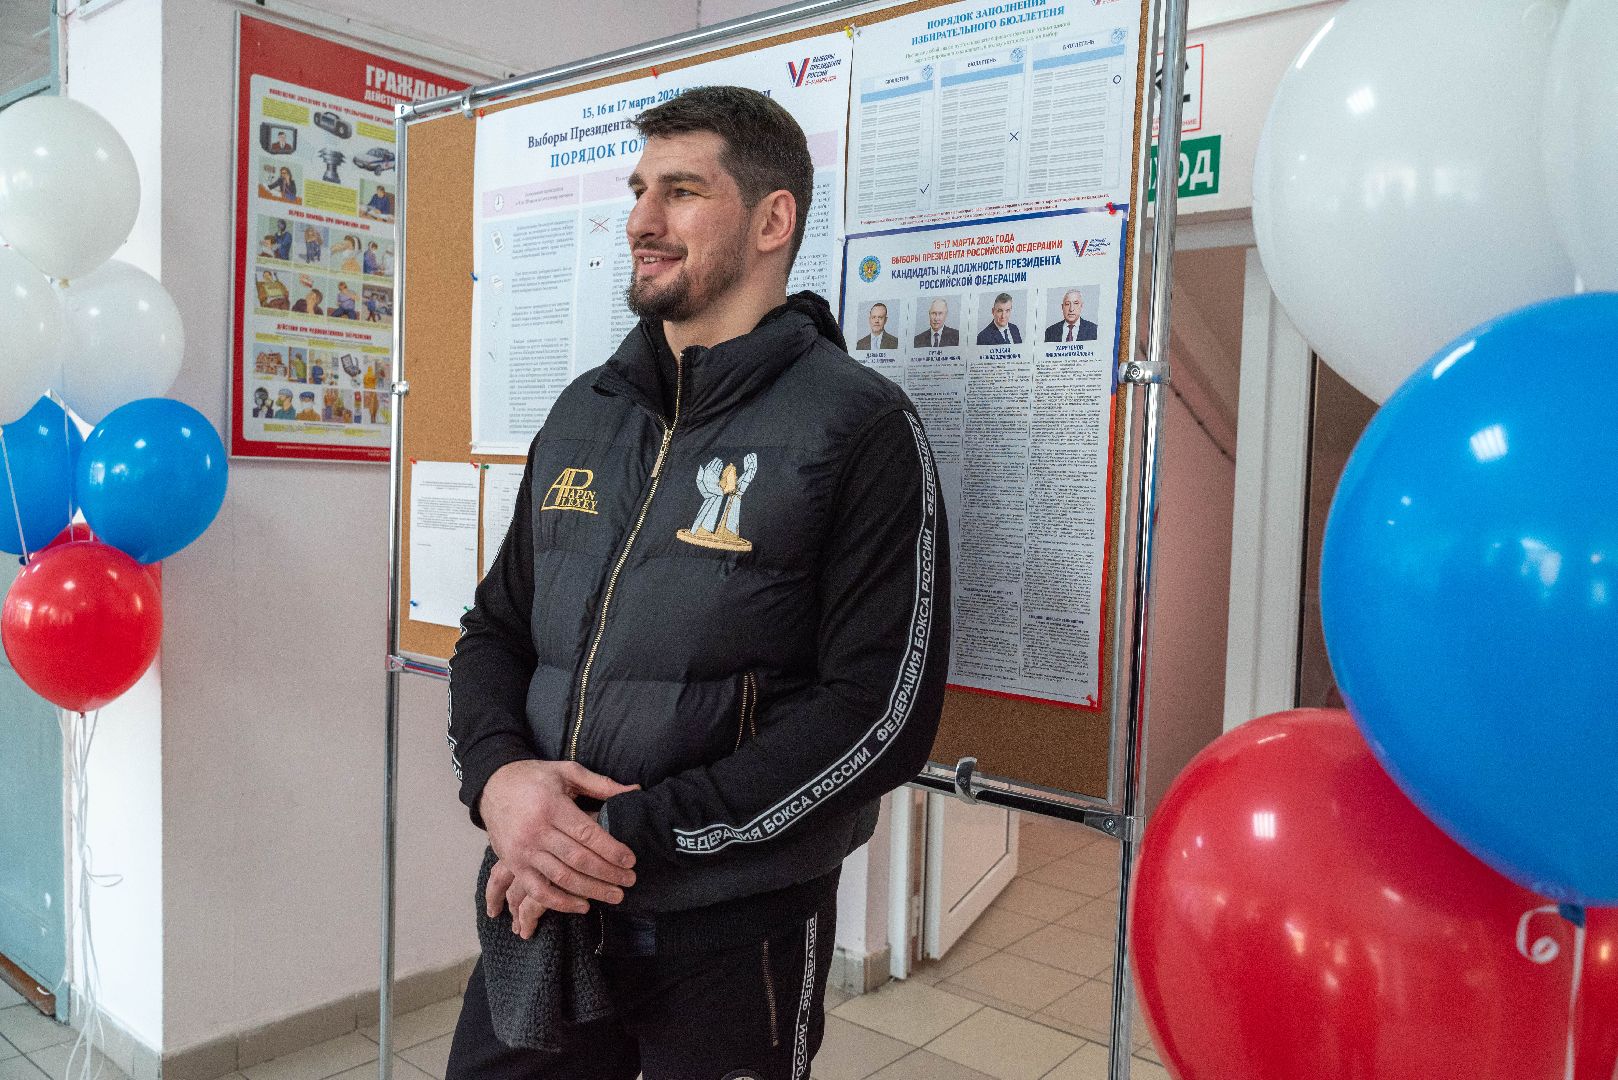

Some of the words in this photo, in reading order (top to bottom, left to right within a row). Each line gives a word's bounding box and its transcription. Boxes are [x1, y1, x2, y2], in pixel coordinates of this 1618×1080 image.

[911, 19, 997, 46] ИЗБИРАТЕЛЬНОГО
[999, 5, 1065, 27] БЮЛЛЕТЕНЯ
[927, 11, 973, 30] ПОРЯДОК
[582, 107, 595, 119] 15,
[597, 104, 607, 116] 16
[608, 104, 615, 113] и
[617, 100, 627, 112] 17
[628, 95, 656, 110] марта
[658, 88, 680, 101] 2024
[528, 131, 568, 149] Выборы
[570, 119, 631, 142] Президента
[551, 143, 616, 168] ПОРЯДОК
[891, 254, 921, 265] ВЫБОРЫ
[922, 249, 965, 262] ПРЕЗИДЕНТА
[967, 243, 1014, 257] РОССИЙСКОЙ
[1016, 239, 1063, 253] ФЕДЕРАЦИИ
[934, 240, 950, 250] 15-17
[952, 237, 975, 248] МАРТА
[976, 235, 994, 246] 2024
[995, 233, 1015, 243] ГОДА
[891, 264, 939, 280] КАНДИДАТЫ
[941, 264, 951, 274] НА
[952, 258, 1003, 275] ДОЛЖНОСТЬ
[1005, 255, 1062, 270] ПРЕЗИДЕНТА
[919, 274, 973, 290] РОССИЙСКОЙ
[974, 272, 1027, 286] ФЕДЕРАЦИИ
[876, 649, 922, 742] ФЕДЕРАЦИЯ
[914, 598, 930, 650] БОКСА
[922, 528, 933, 593] РОССИИ
[676, 825, 763, 851] ФЕДЕРАЦИЯ
[762, 795, 814, 834] БОКСА
[812, 747, 872, 799] РОССИИ
[796, 1023, 808, 1080] ОССИИ
[802, 917, 815, 1011] ФЕДЕРАЦИЯ
